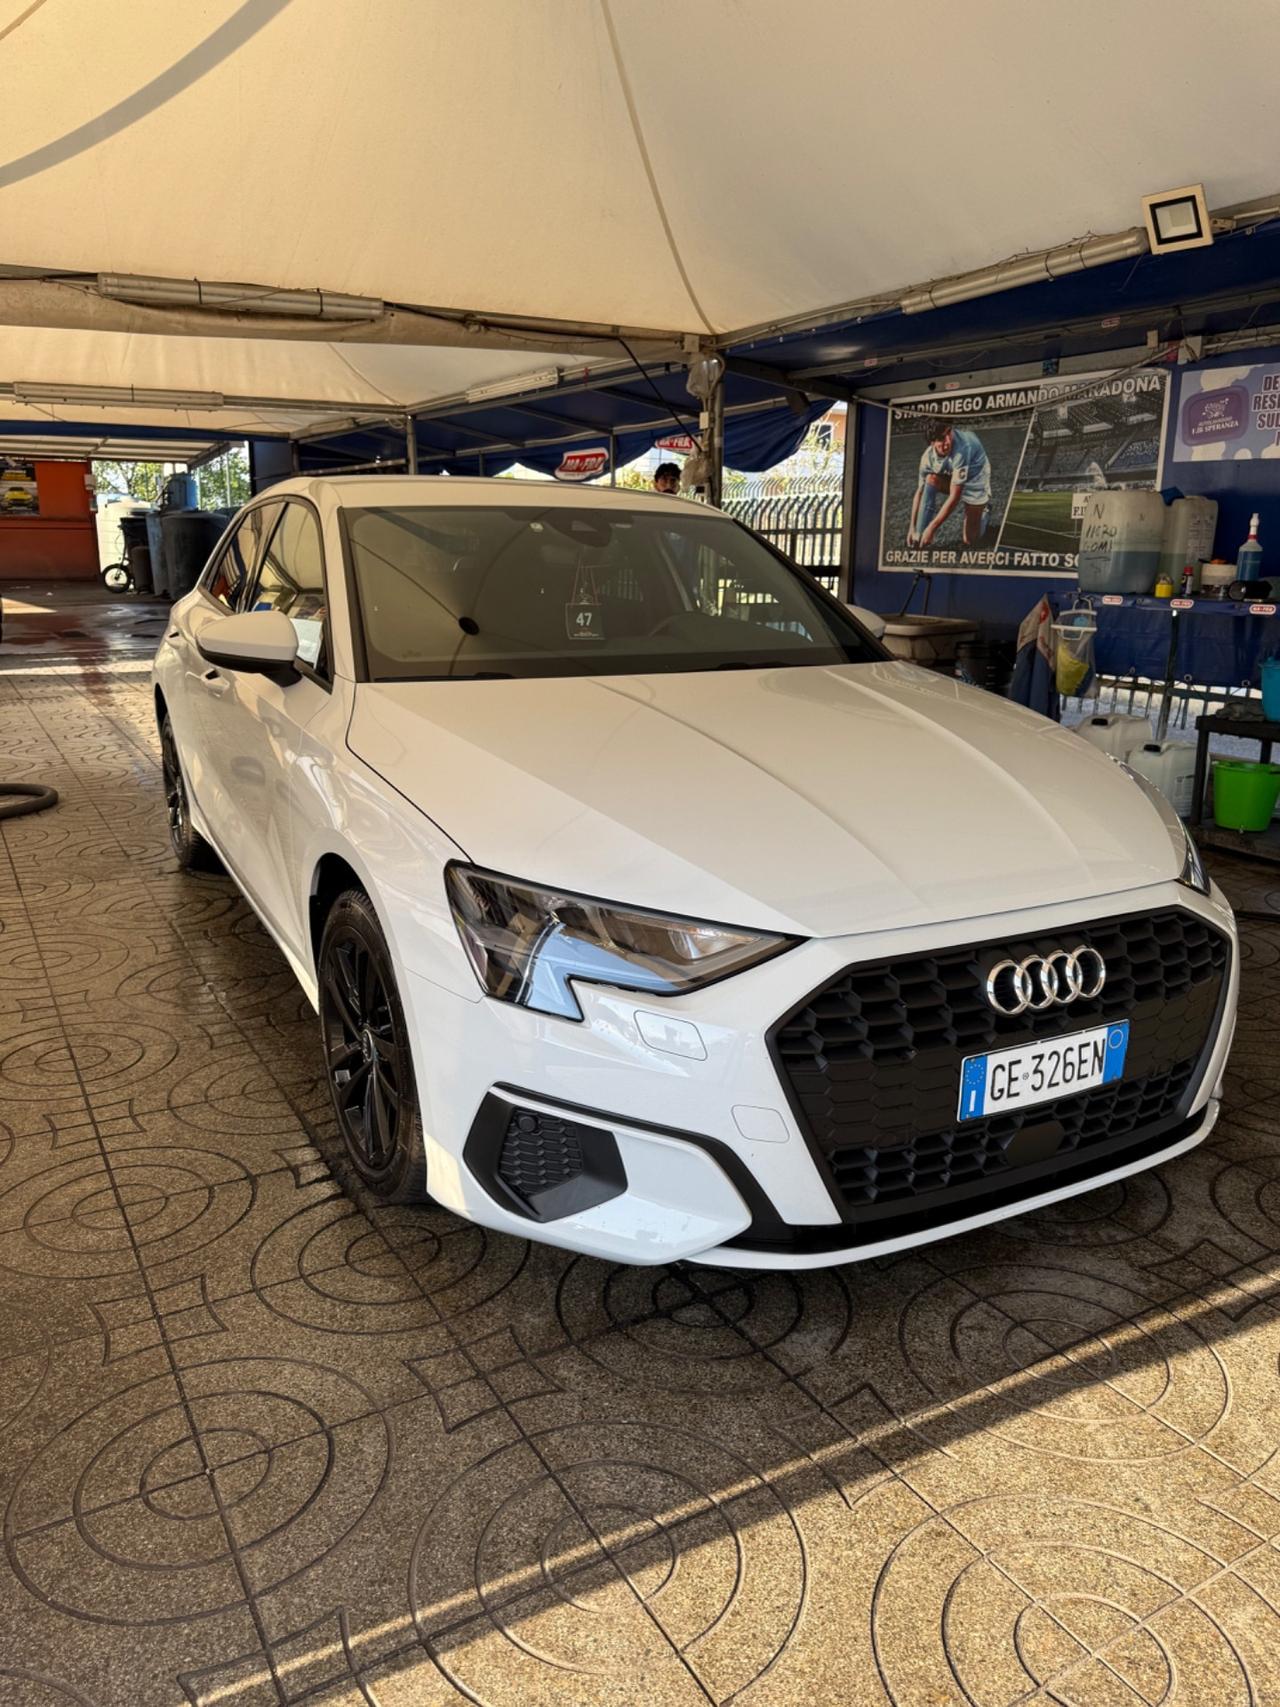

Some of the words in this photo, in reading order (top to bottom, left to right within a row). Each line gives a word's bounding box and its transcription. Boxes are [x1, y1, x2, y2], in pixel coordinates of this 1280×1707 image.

[894, 402, 938, 420] STADIO
[942, 396, 983, 414] DIEGO
[985, 387, 1060, 410] ARMANDO
[1063, 375, 1162, 401] MARADONA
[885, 550, 929, 564] GRAZIE
[932, 551, 956, 564] PER
[959, 551, 1010, 566] AVERCI
[1013, 553, 1060, 568] FATTO
[575, 611, 593, 627] 47
